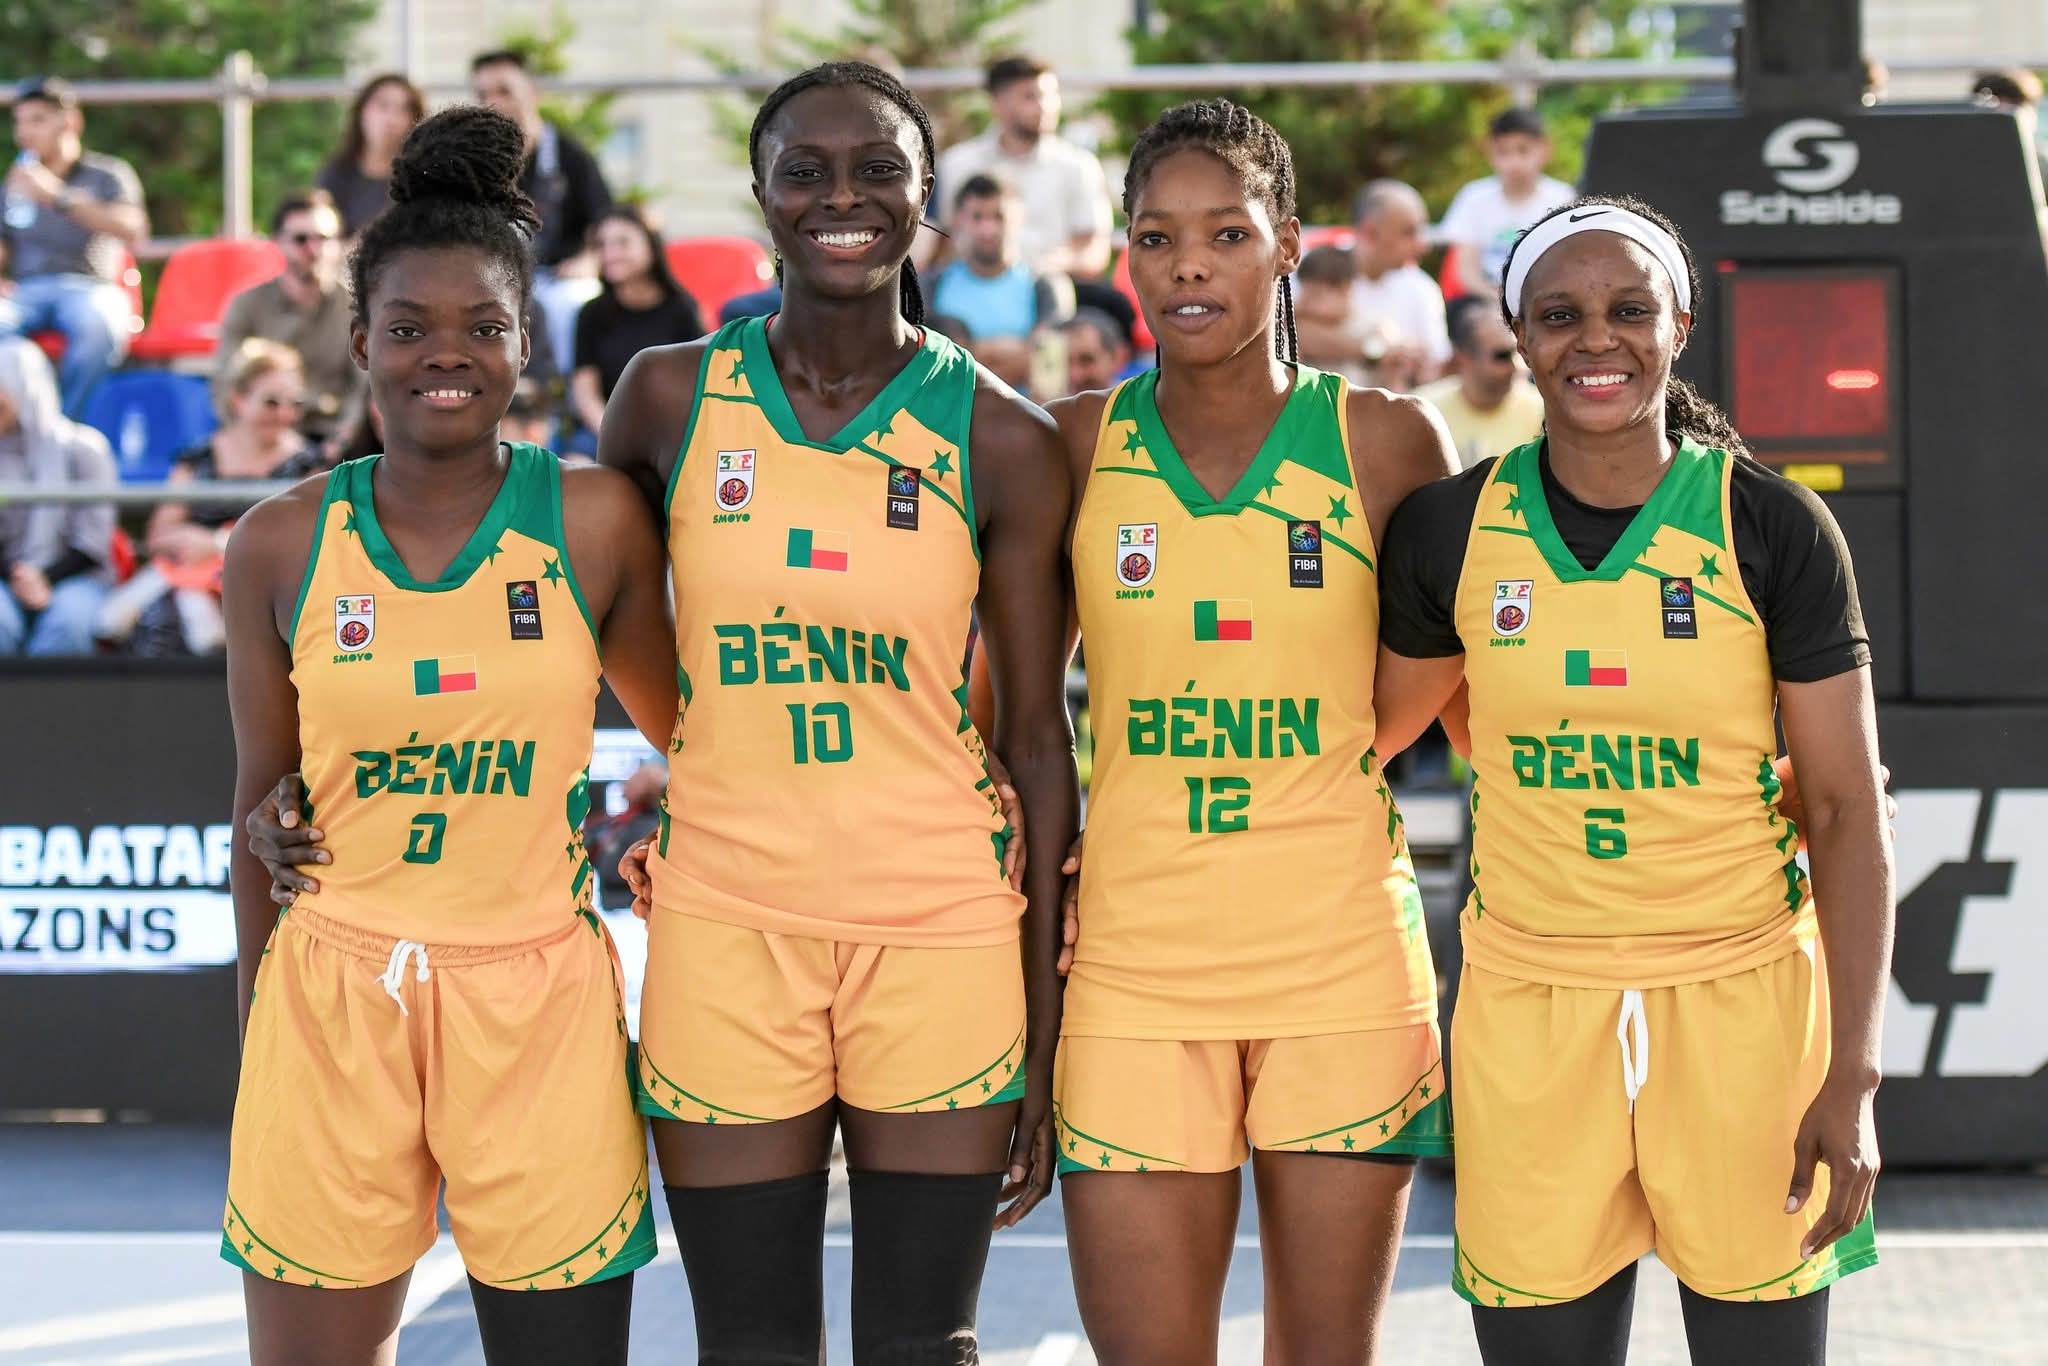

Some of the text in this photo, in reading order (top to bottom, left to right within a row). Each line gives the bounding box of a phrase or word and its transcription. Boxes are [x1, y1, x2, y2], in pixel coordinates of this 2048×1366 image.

[892, 501, 914, 514] FIBA
[713, 513, 751, 523] SMOYO
[1294, 559, 1318, 571] FIBA
[1116, 588, 1155, 600] SMOYO
[514, 613, 537, 625] FIBA
[1667, 612, 1691, 624] FIBA
[1488, 637, 1527, 648] SMOYO
[333, 652, 373, 664] SMOYO
[787, 702, 854, 764] 10
[1185, 775, 1251, 834] 12
[402, 812, 448, 865] 0
[1585, 807, 1628, 860] 6
[0, 907, 177, 953] ZONS
